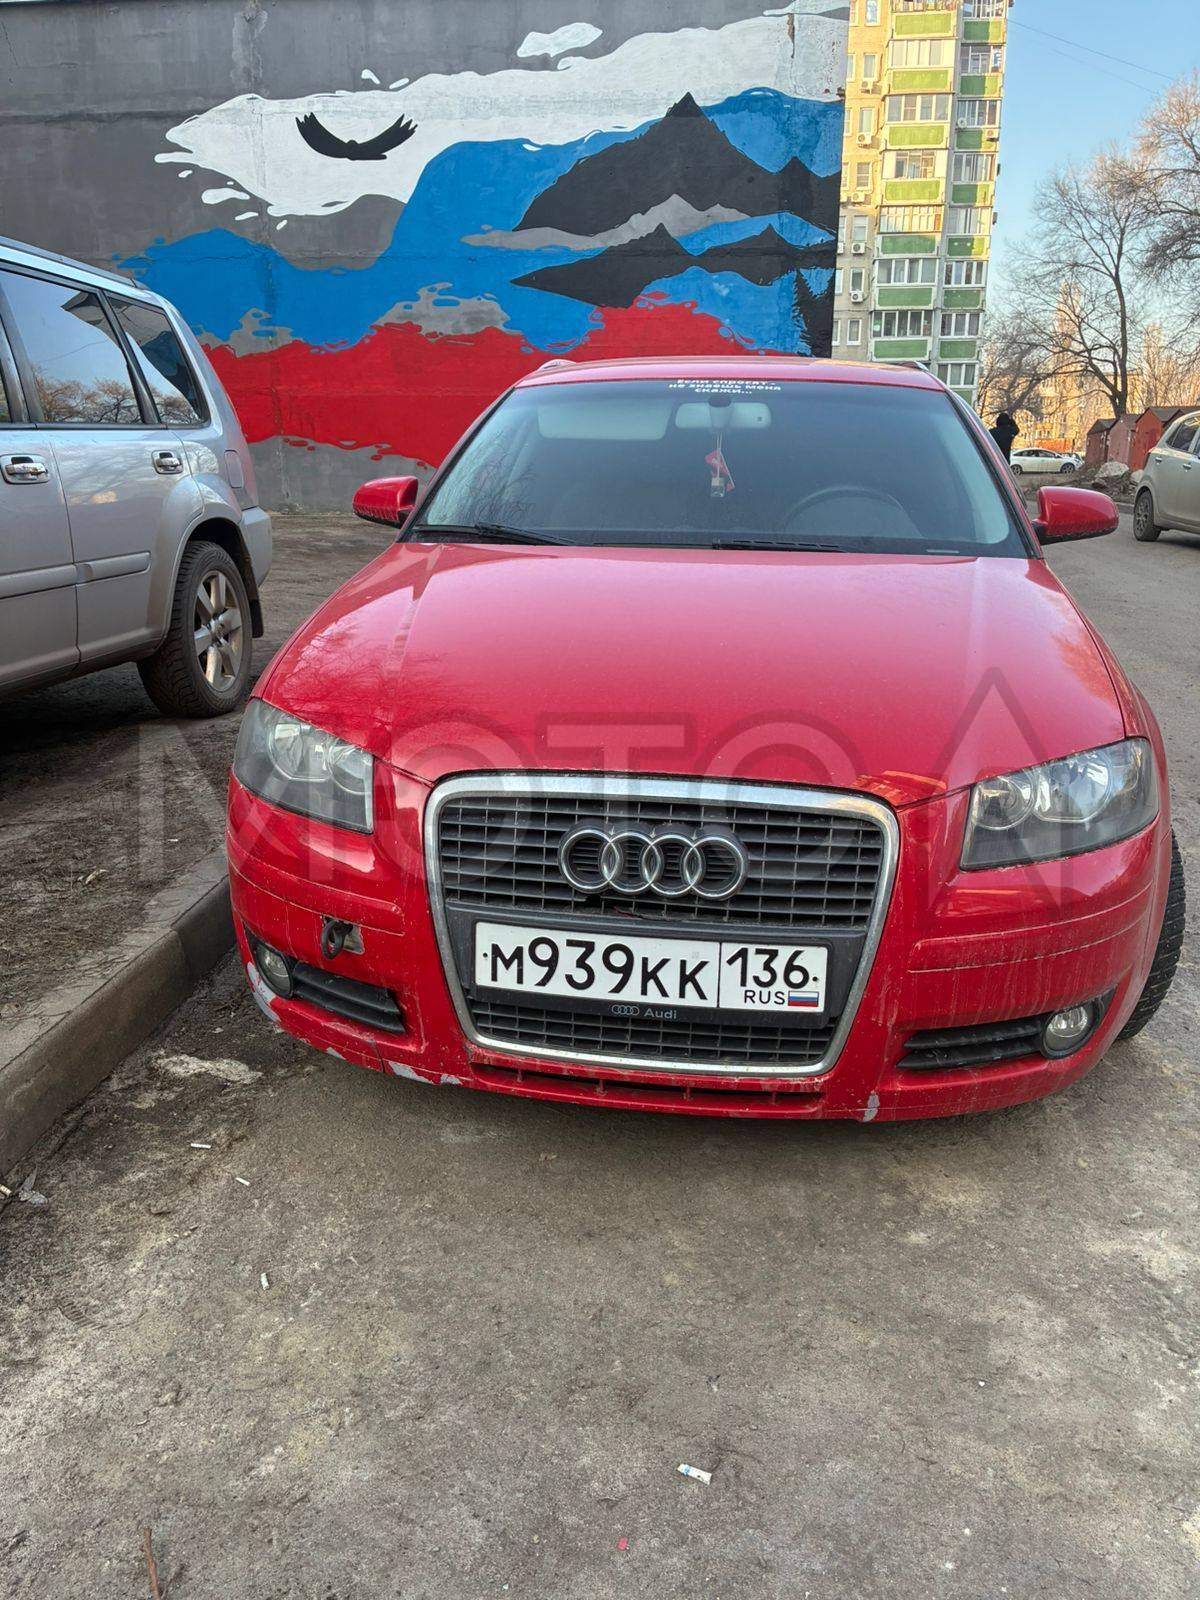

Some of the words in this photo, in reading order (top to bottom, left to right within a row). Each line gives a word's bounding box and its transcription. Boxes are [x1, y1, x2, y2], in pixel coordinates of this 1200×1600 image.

[490, 936, 710, 1000] М939КК
[726, 948, 810, 990] 136
[744, 990, 786, 1005] RUS
[643, 1007, 677, 1019] Audi
